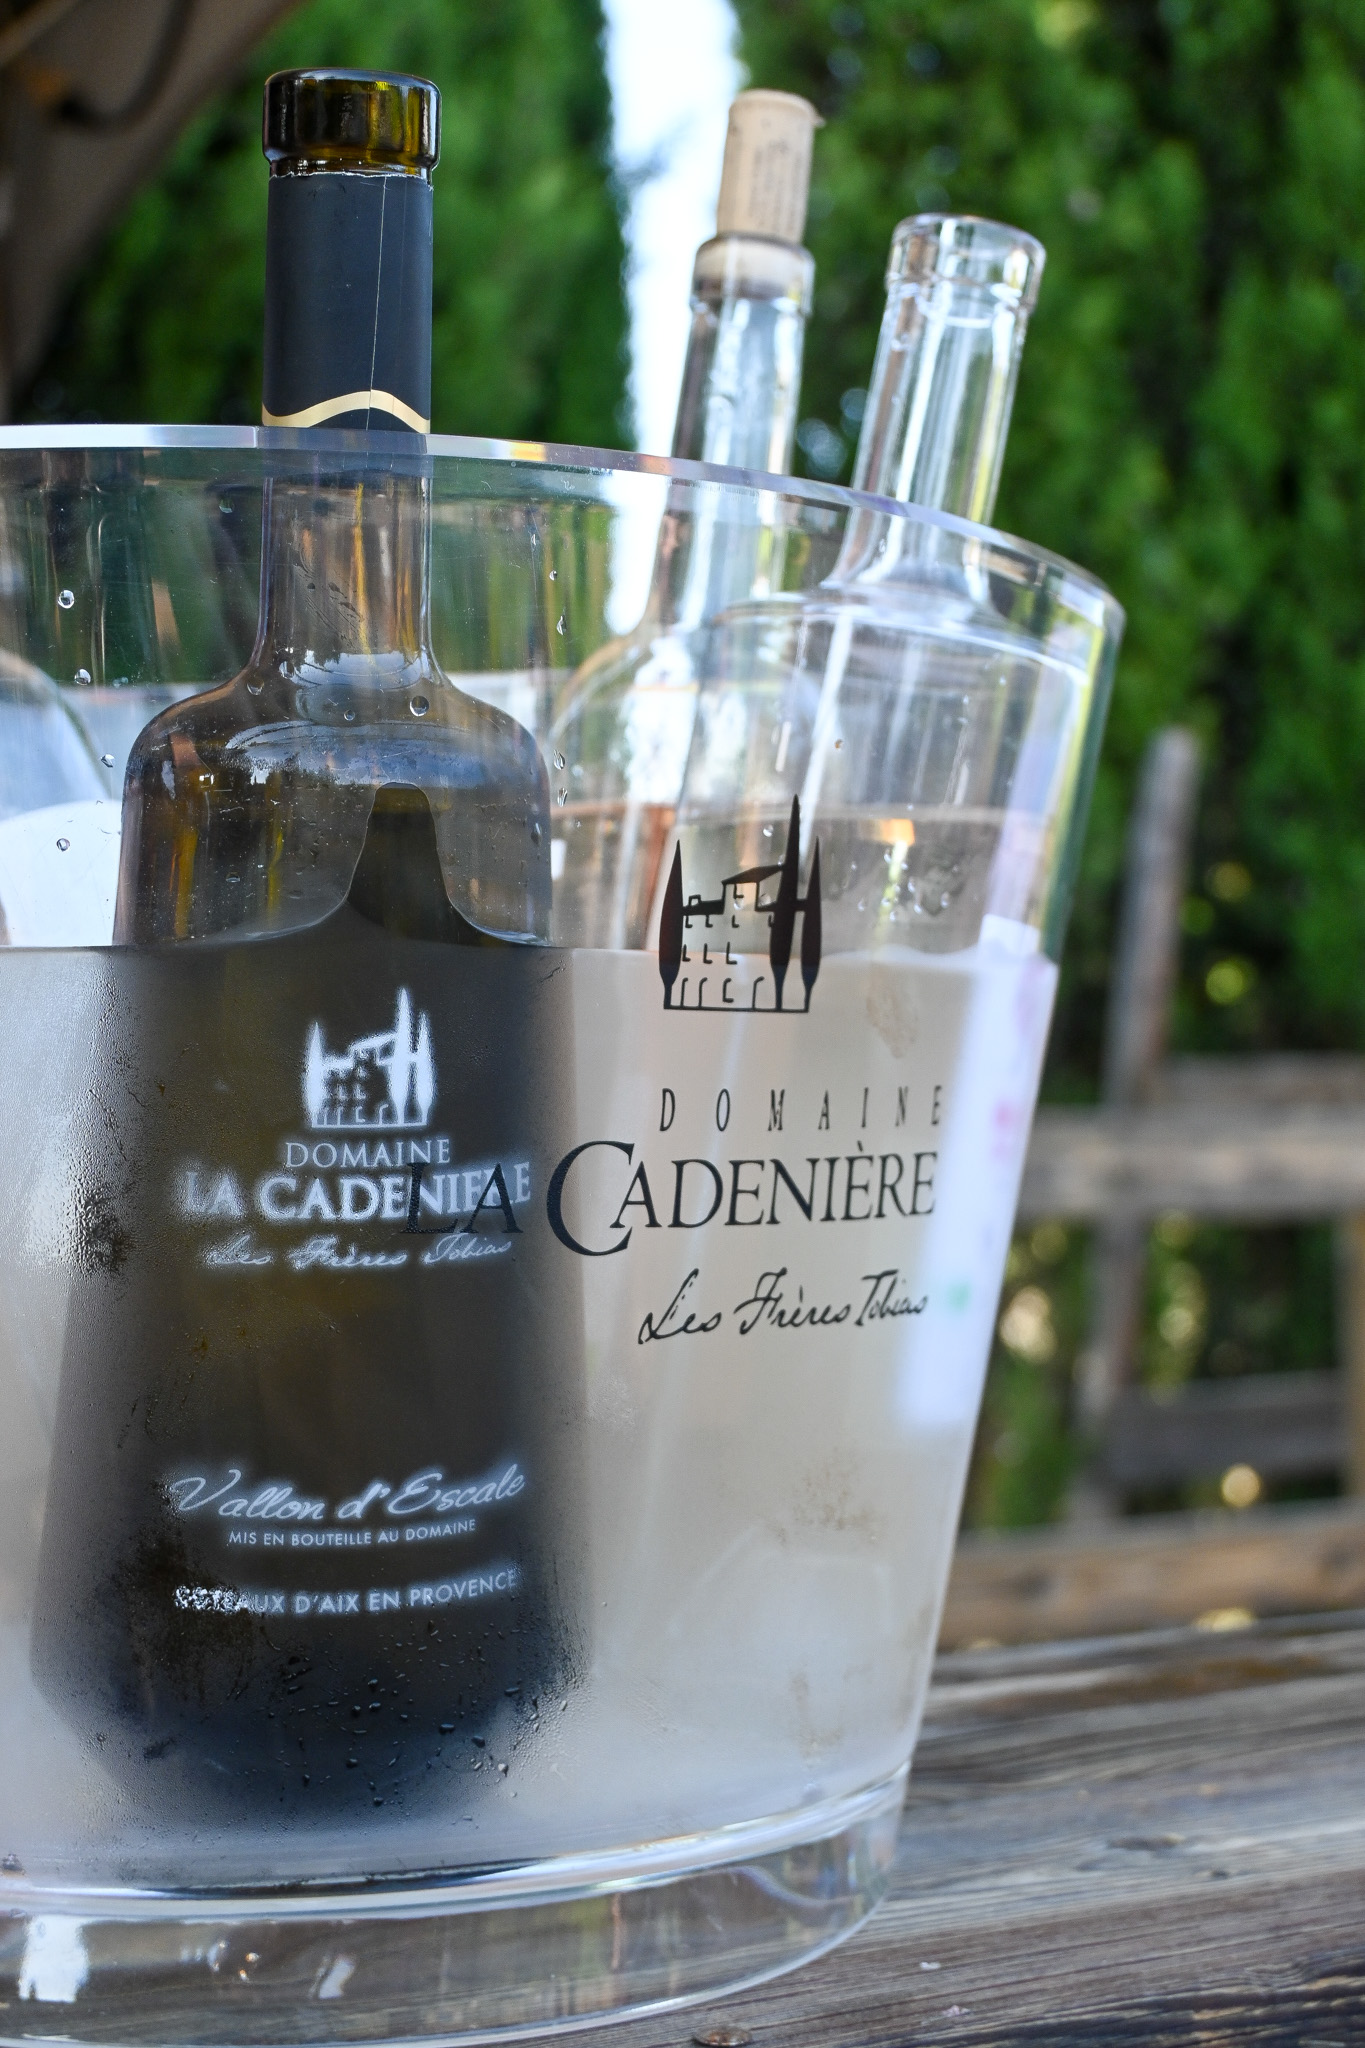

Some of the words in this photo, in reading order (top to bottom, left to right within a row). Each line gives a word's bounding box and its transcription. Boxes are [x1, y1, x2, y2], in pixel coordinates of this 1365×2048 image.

[659, 1085, 942, 1132] DOMAINE
[285, 1138, 450, 1168] DOMAINE
[184, 1170, 244, 1217] LA
[399, 1162, 524, 1233] LA
[546, 1140, 938, 1257] CADENIÈRE
[637, 1268, 722, 1345] Les
[173, 1469, 325, 1521] Vallon
[228, 1530, 257, 1545] MIS
[264, 1532, 284, 1547] EN
[291, 1531, 372, 1547] BOUTEILLE
[377, 1529, 399, 1543] AU
[405, 1519, 476, 1541] DOMAINE
[295, 1593, 359, 1615] D'AIX
[368, 1590, 400, 1613] EN
[409, 1567, 518, 1607] PROVENCE
